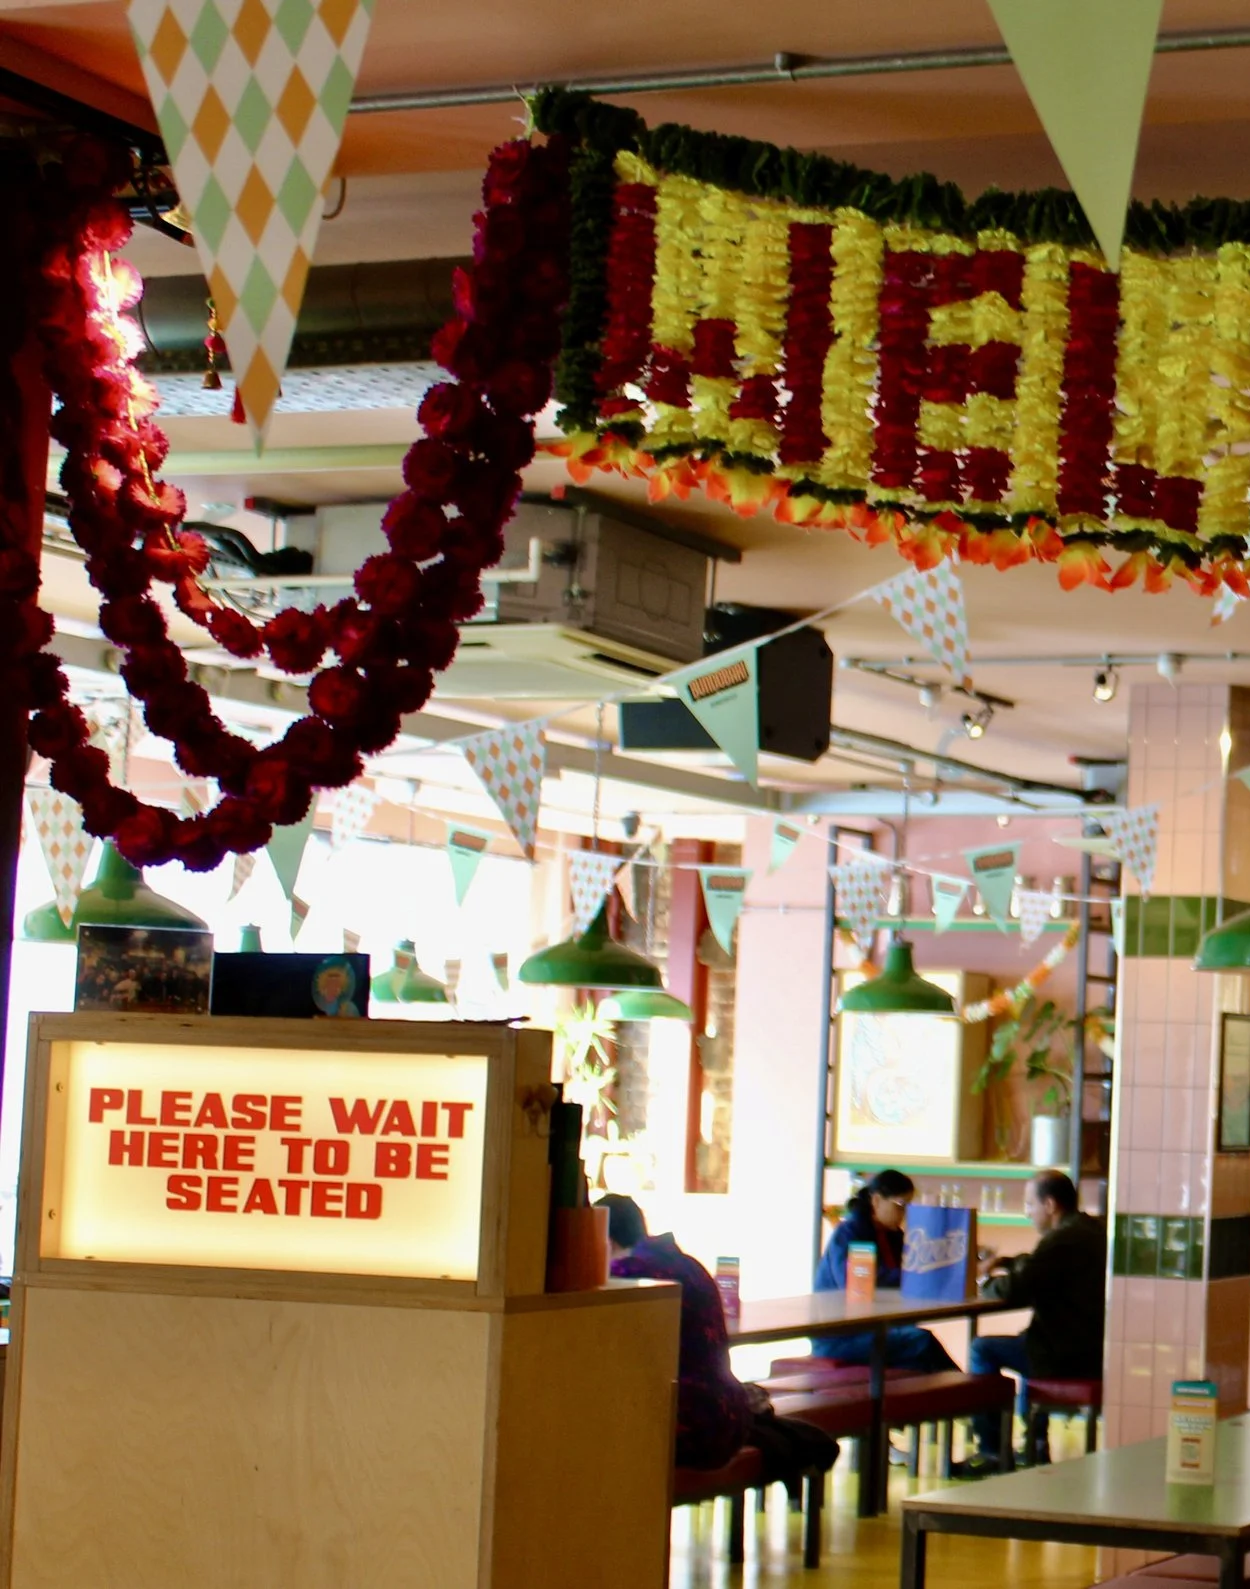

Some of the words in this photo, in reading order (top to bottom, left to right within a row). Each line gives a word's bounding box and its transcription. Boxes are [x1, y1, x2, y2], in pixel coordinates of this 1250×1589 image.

[89, 1087, 303, 1132] PLEASE
[329, 1097, 473, 1139] WAIT
[108, 1129, 257, 1172] HERE
[280, 1136, 351, 1177] TO
[374, 1141, 449, 1181] BE
[166, 1173, 384, 1220] SEATED
